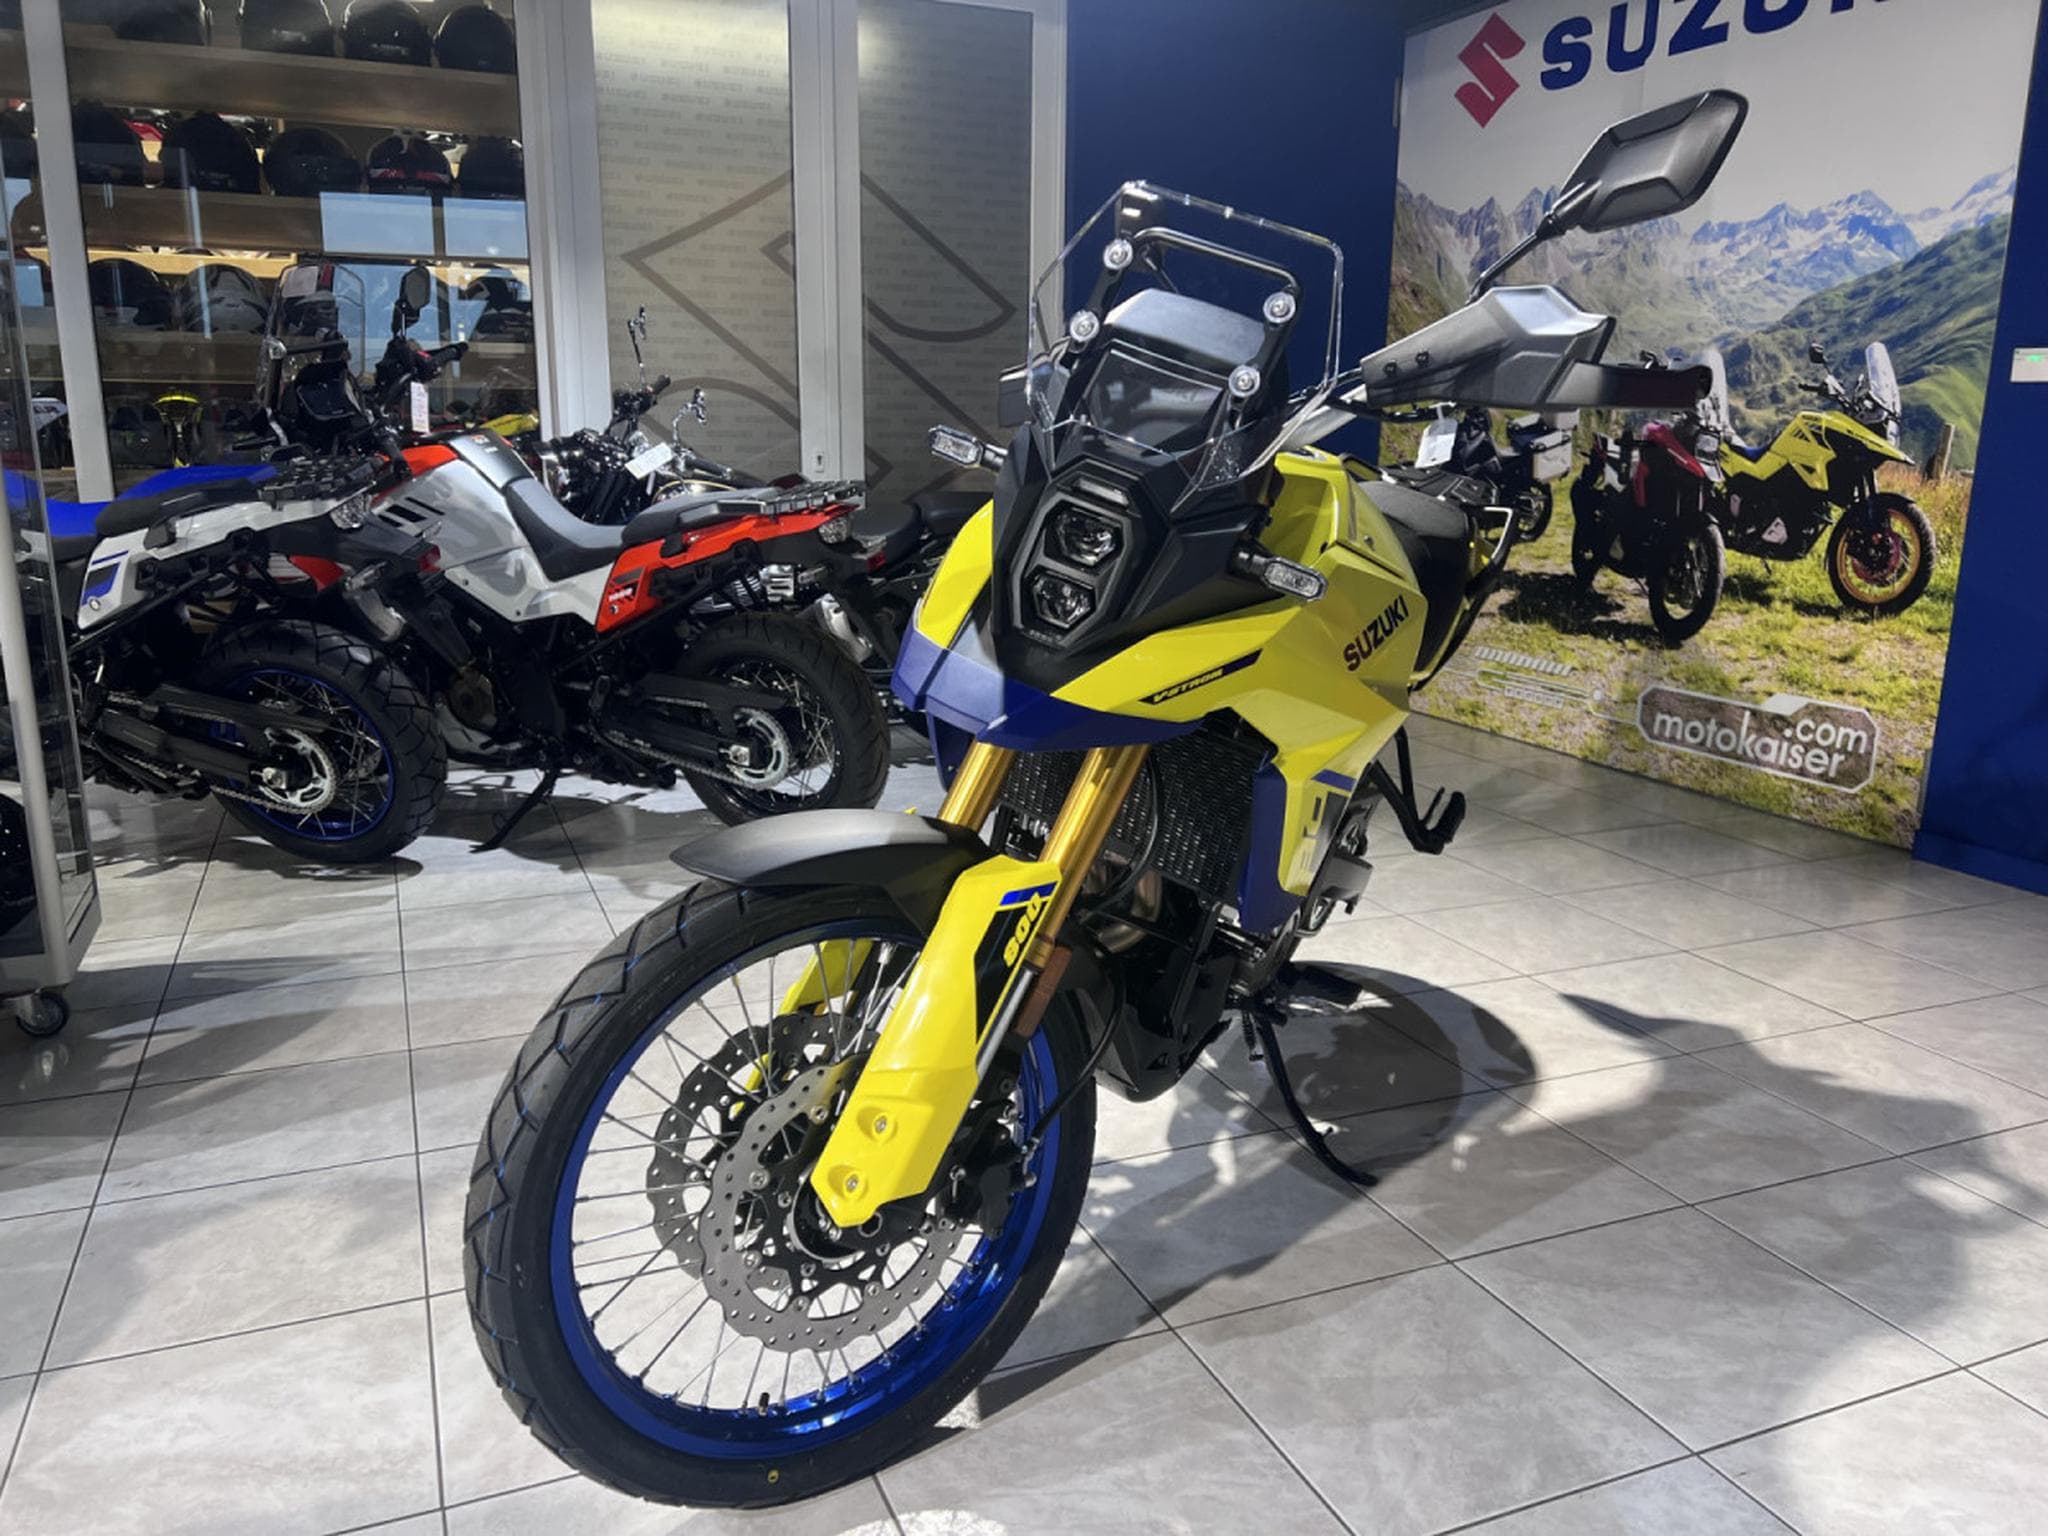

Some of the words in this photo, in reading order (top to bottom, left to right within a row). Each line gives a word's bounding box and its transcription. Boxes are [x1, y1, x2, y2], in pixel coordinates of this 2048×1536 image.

[1540, 0, 1890, 91] SUZ
[1343, 595, 1409, 672] SUZUKI
[1653, 709, 1845, 778] motokaiser
[1784, 716, 1868, 754] .com
[1003, 892, 1042, 967] 800
